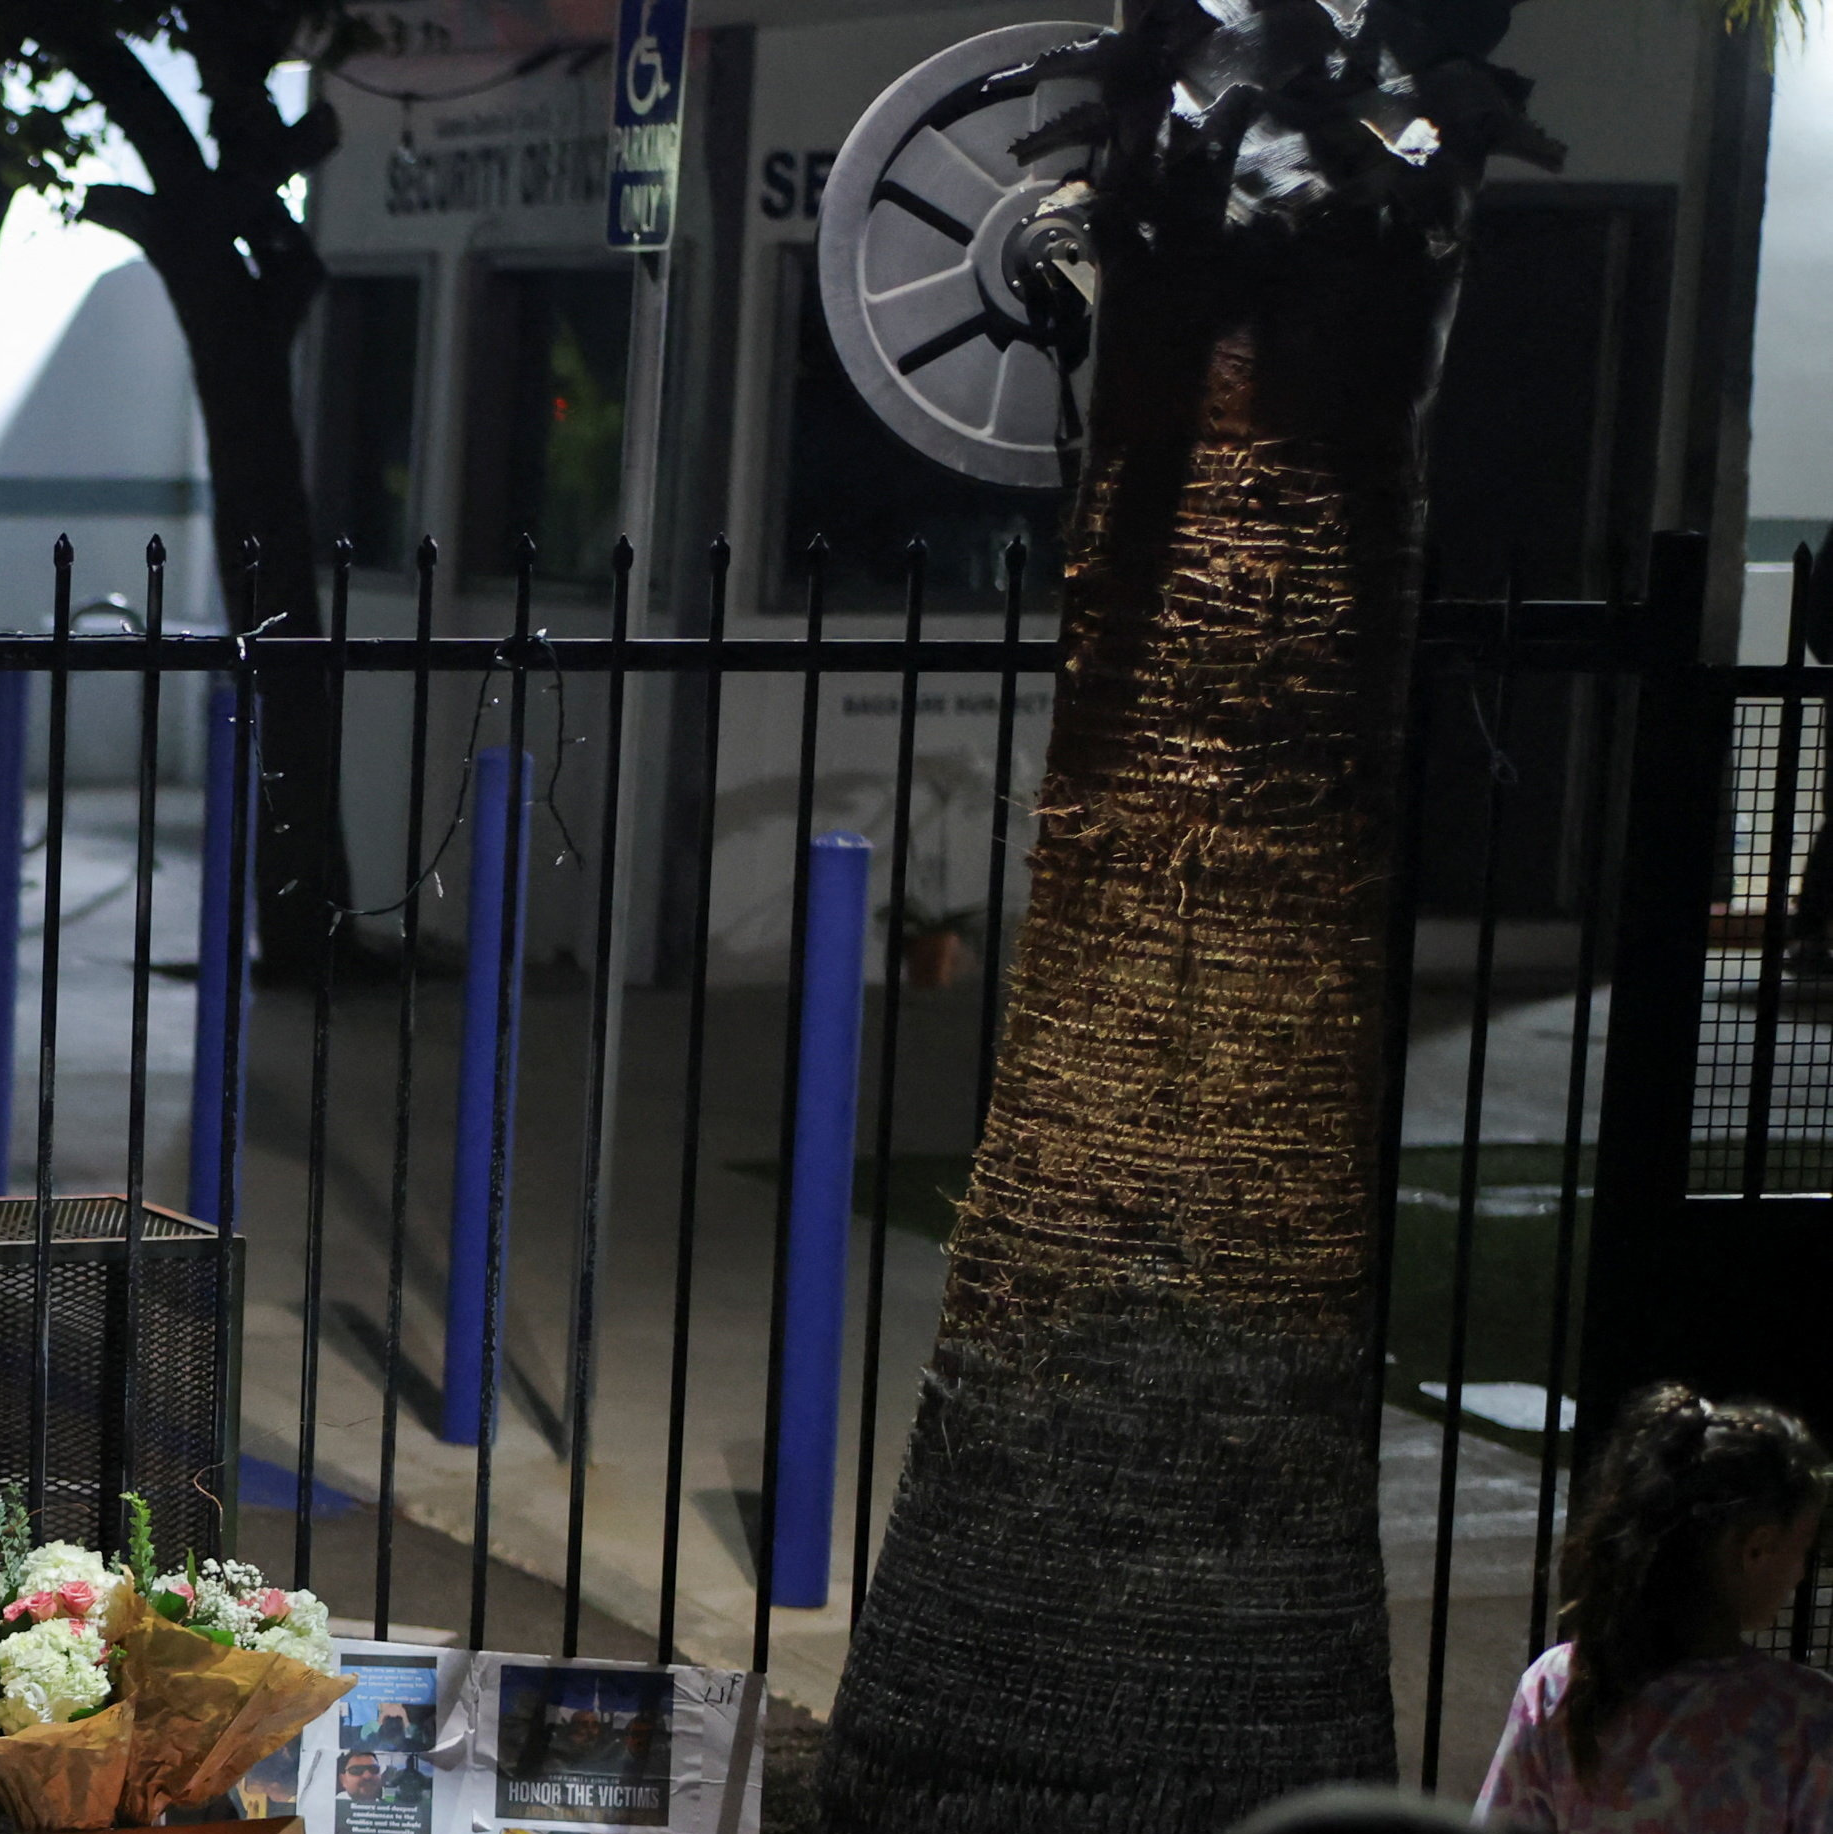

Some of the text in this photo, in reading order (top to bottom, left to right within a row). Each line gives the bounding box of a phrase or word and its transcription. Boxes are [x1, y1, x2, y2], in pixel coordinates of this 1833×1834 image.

[760, 151, 837, 219] SE
[508, 1780, 660, 1809] HONOR THE VICTIMS
